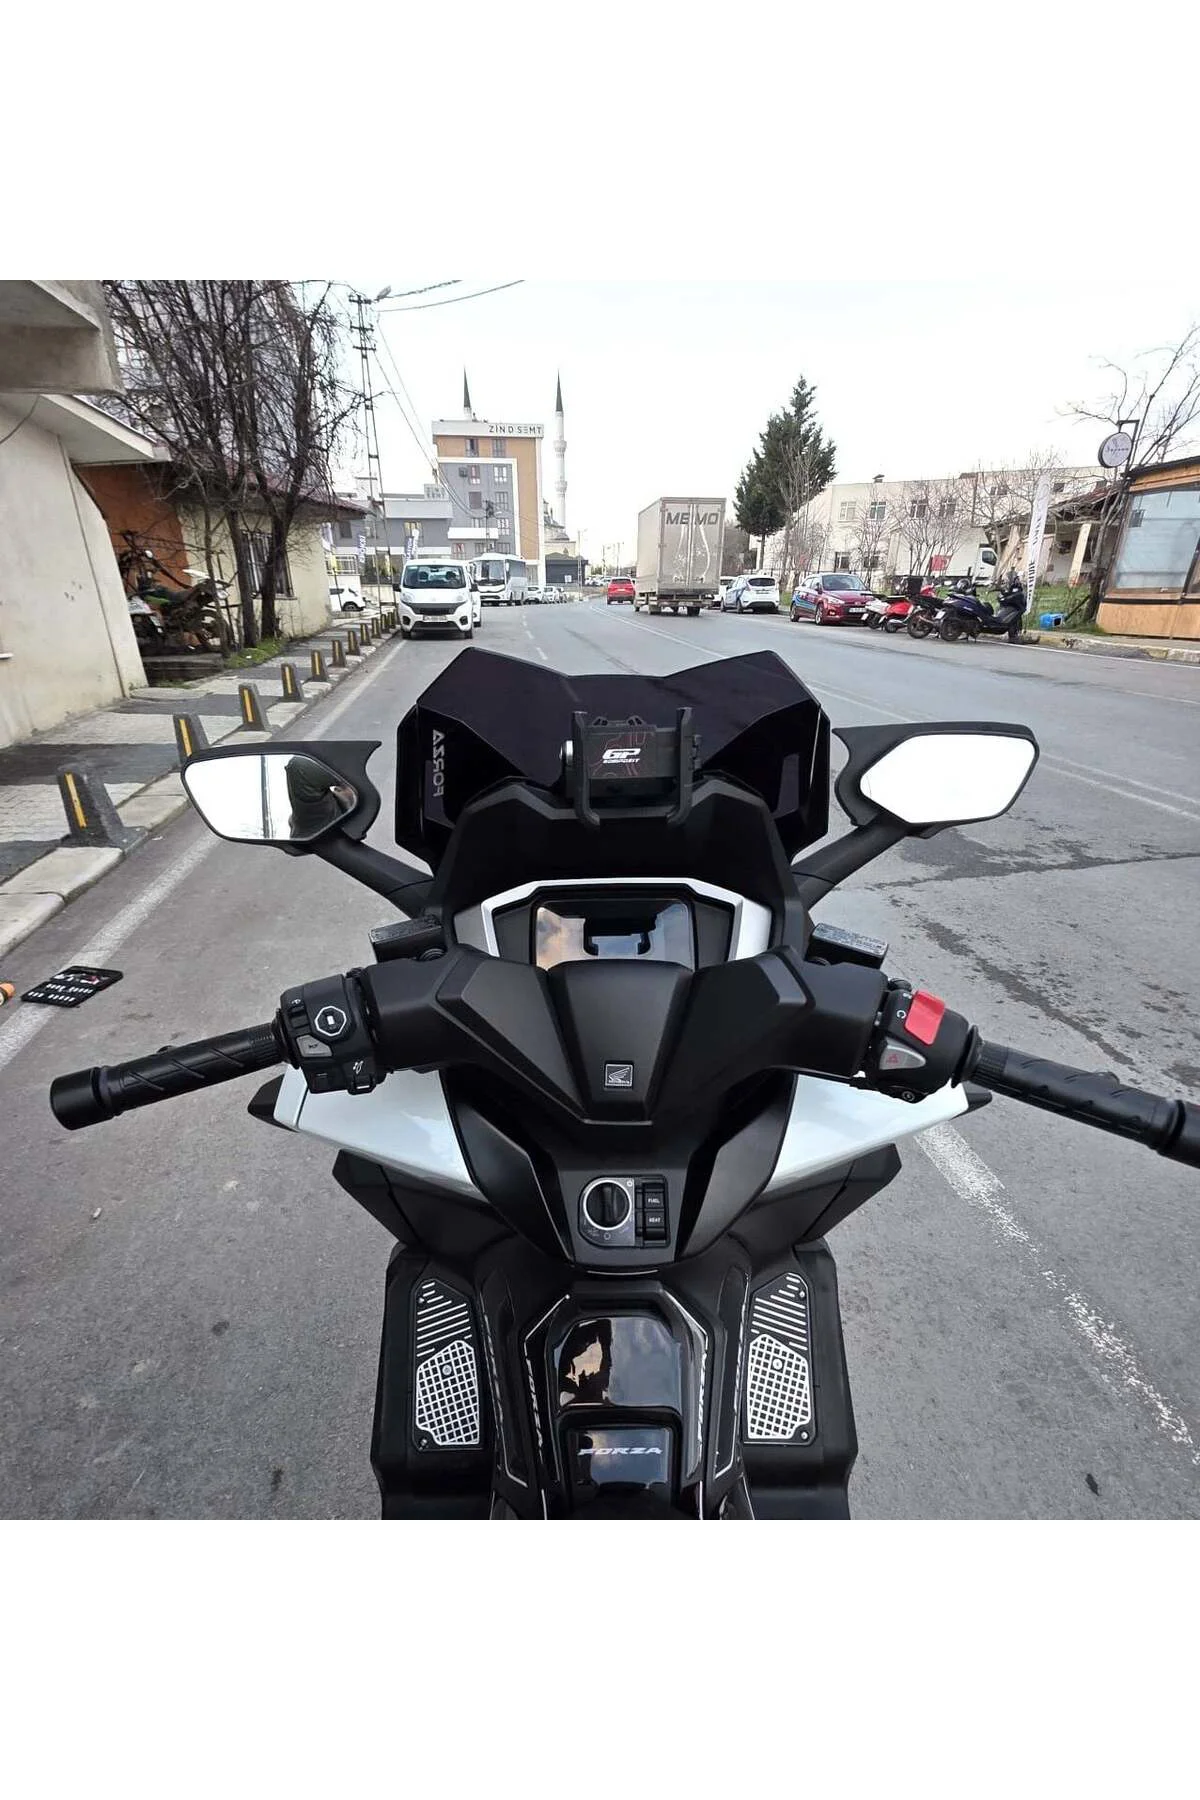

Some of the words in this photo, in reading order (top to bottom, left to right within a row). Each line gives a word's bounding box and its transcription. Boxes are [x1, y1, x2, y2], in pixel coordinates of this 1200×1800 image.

[666, 512, 719, 525] MEMO
[602, 748, 641, 760] GP
[577, 1447, 663, 1456] FORZA
